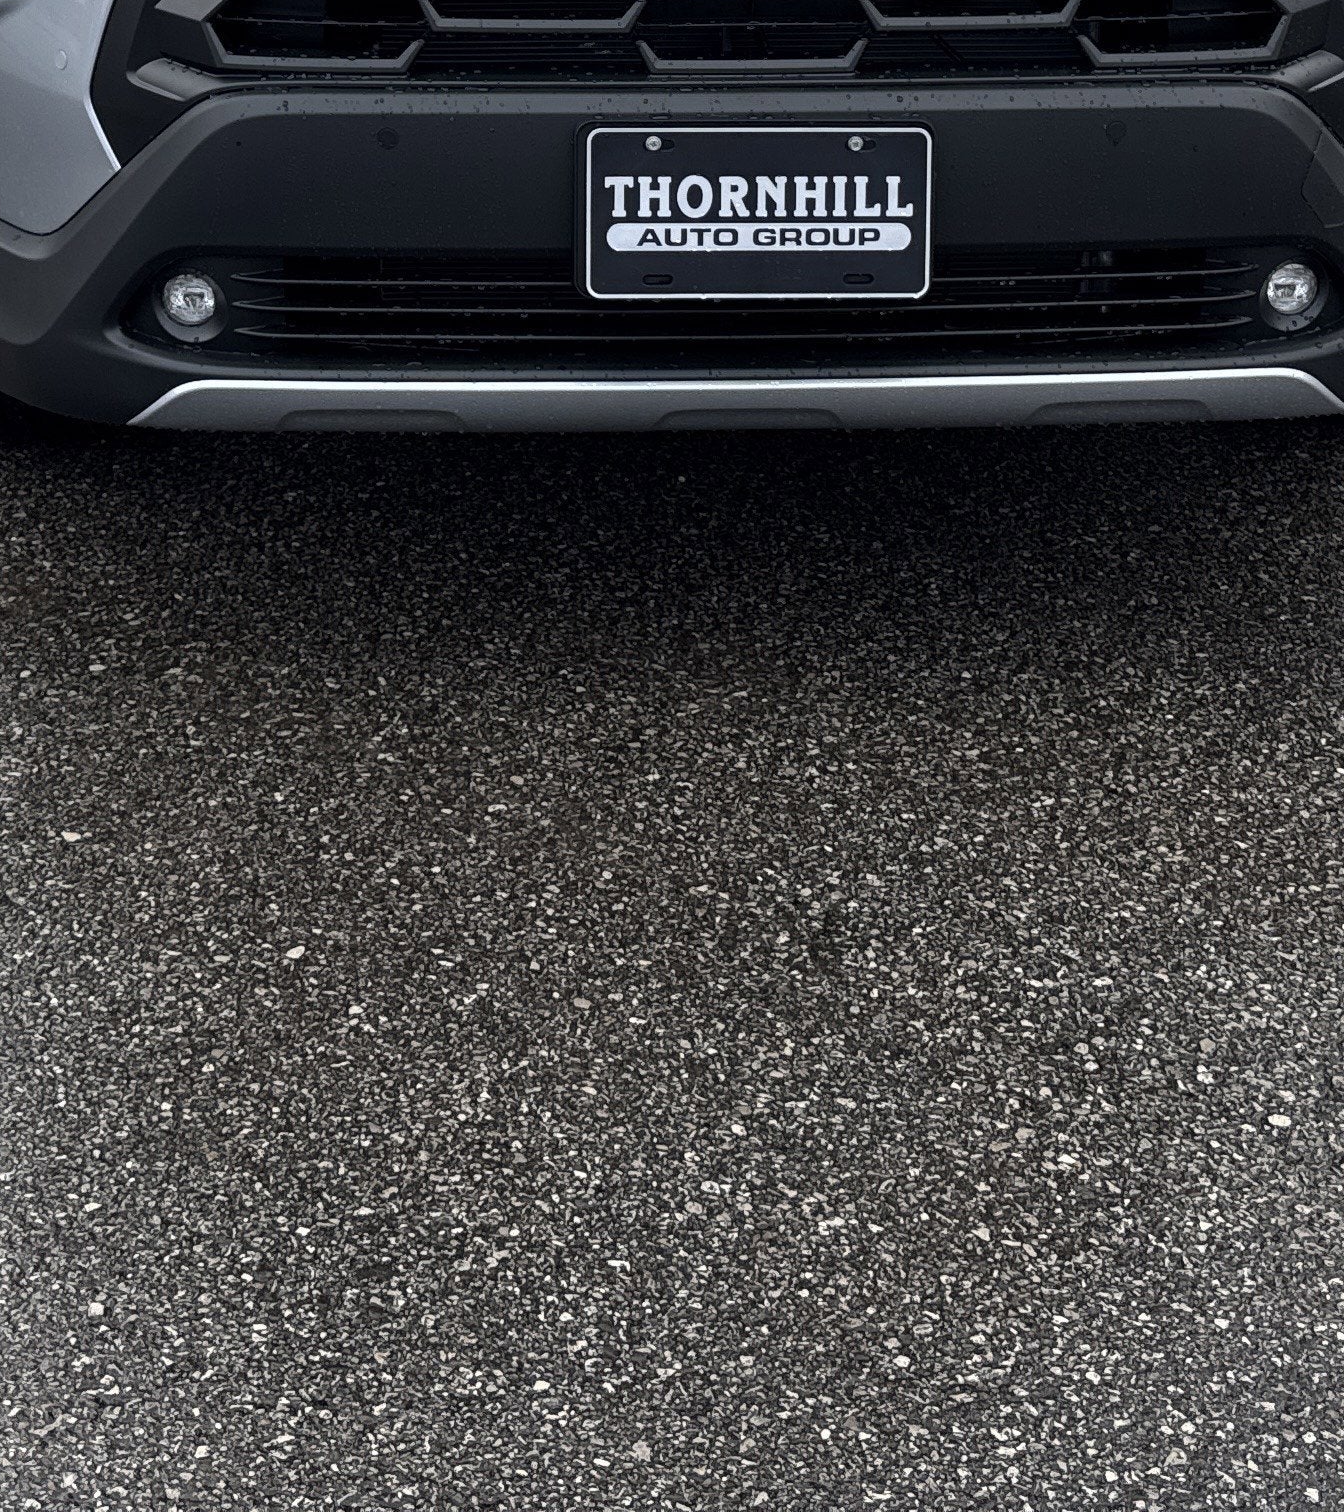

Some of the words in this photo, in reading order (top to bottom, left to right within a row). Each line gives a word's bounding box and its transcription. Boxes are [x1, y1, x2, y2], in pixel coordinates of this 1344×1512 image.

[604, 175, 914, 218] THORNHILL
[637, 228, 739, 246] AUTO
[753, 228, 881, 246] GROUP
